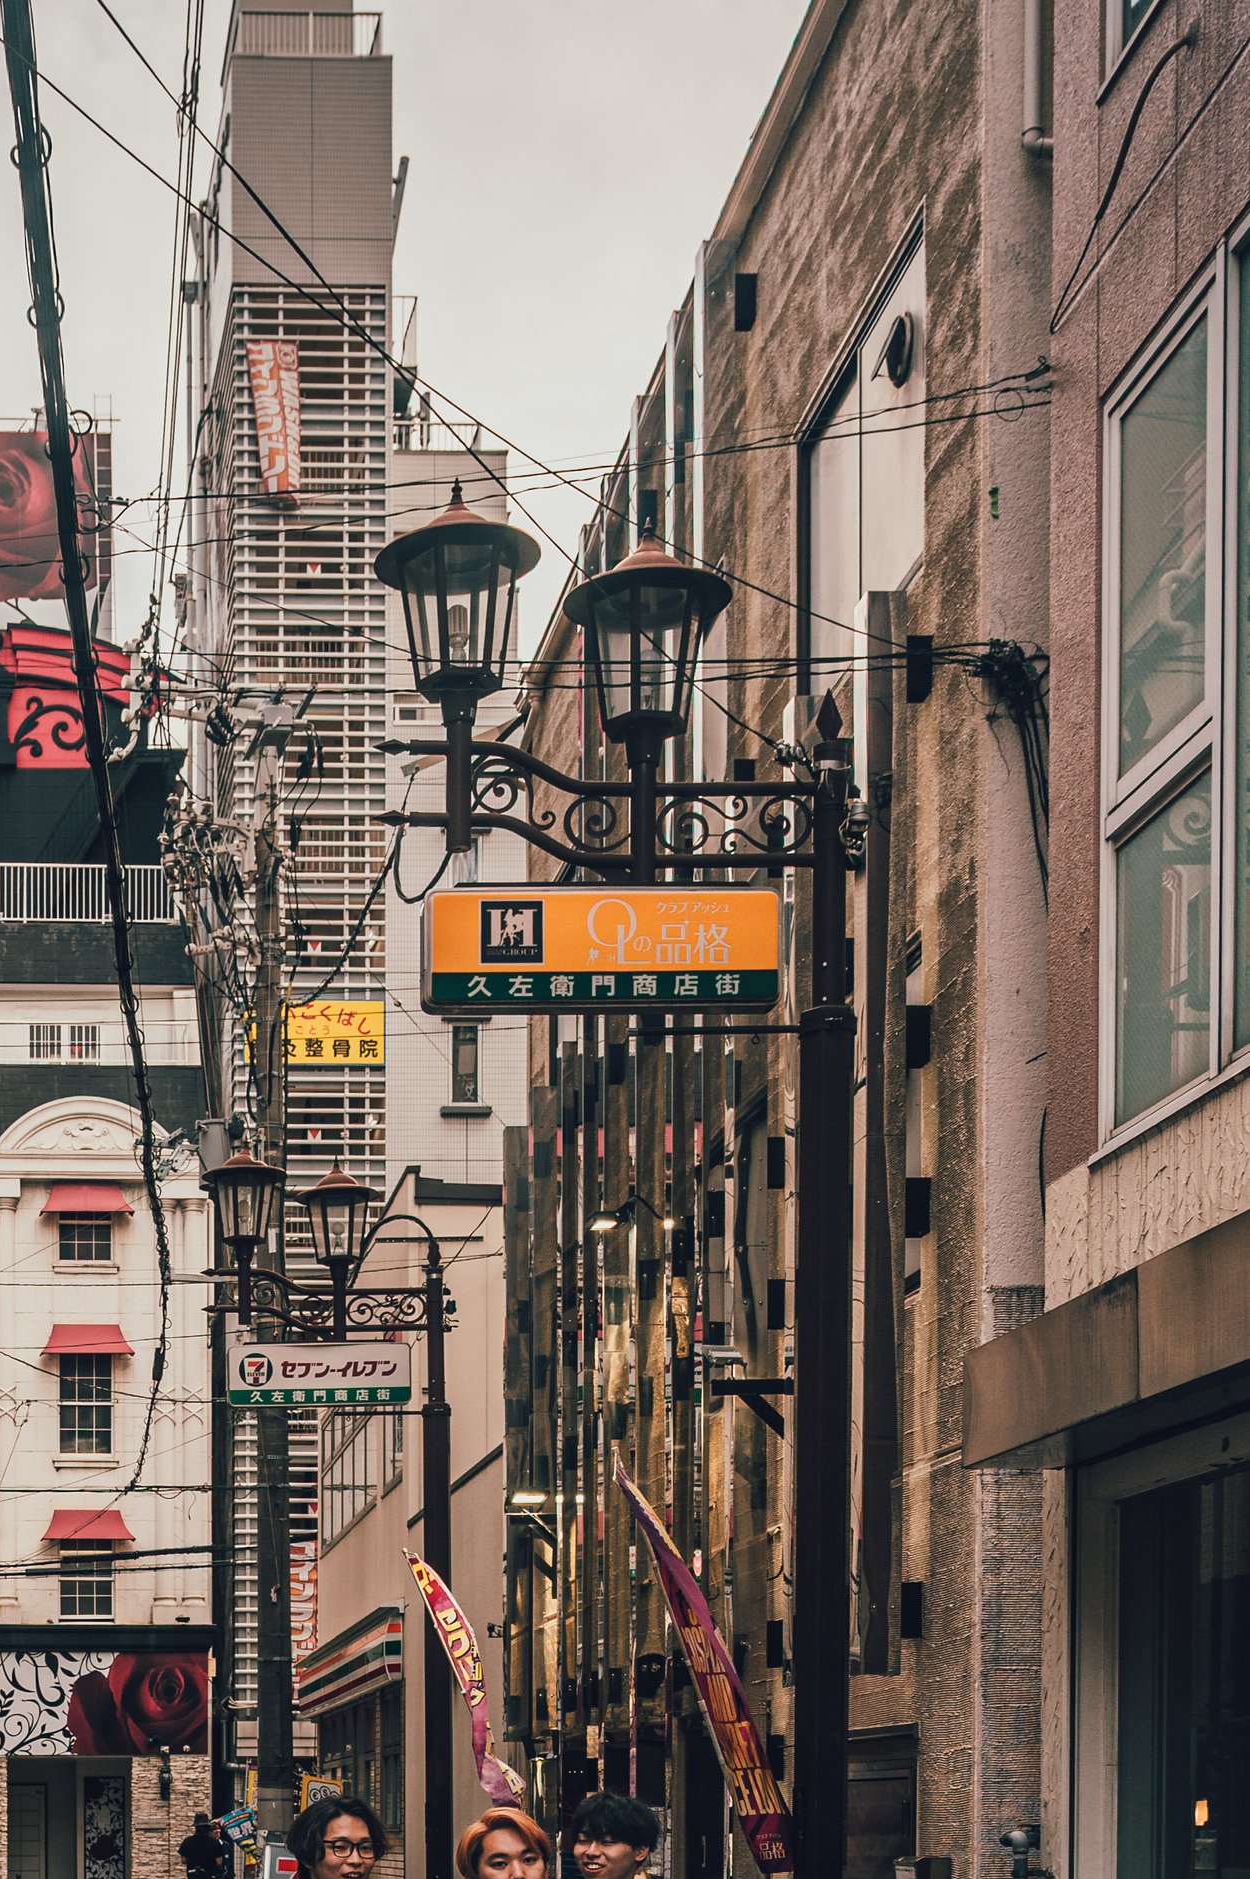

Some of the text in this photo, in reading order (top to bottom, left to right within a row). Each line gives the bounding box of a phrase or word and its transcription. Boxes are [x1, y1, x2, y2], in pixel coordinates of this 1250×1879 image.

[467, 973, 741, 998] 久左衛門商店街
[249, 1389, 391, 1403] 久左衛門商店街
[706, 1673, 737, 1722] AND
